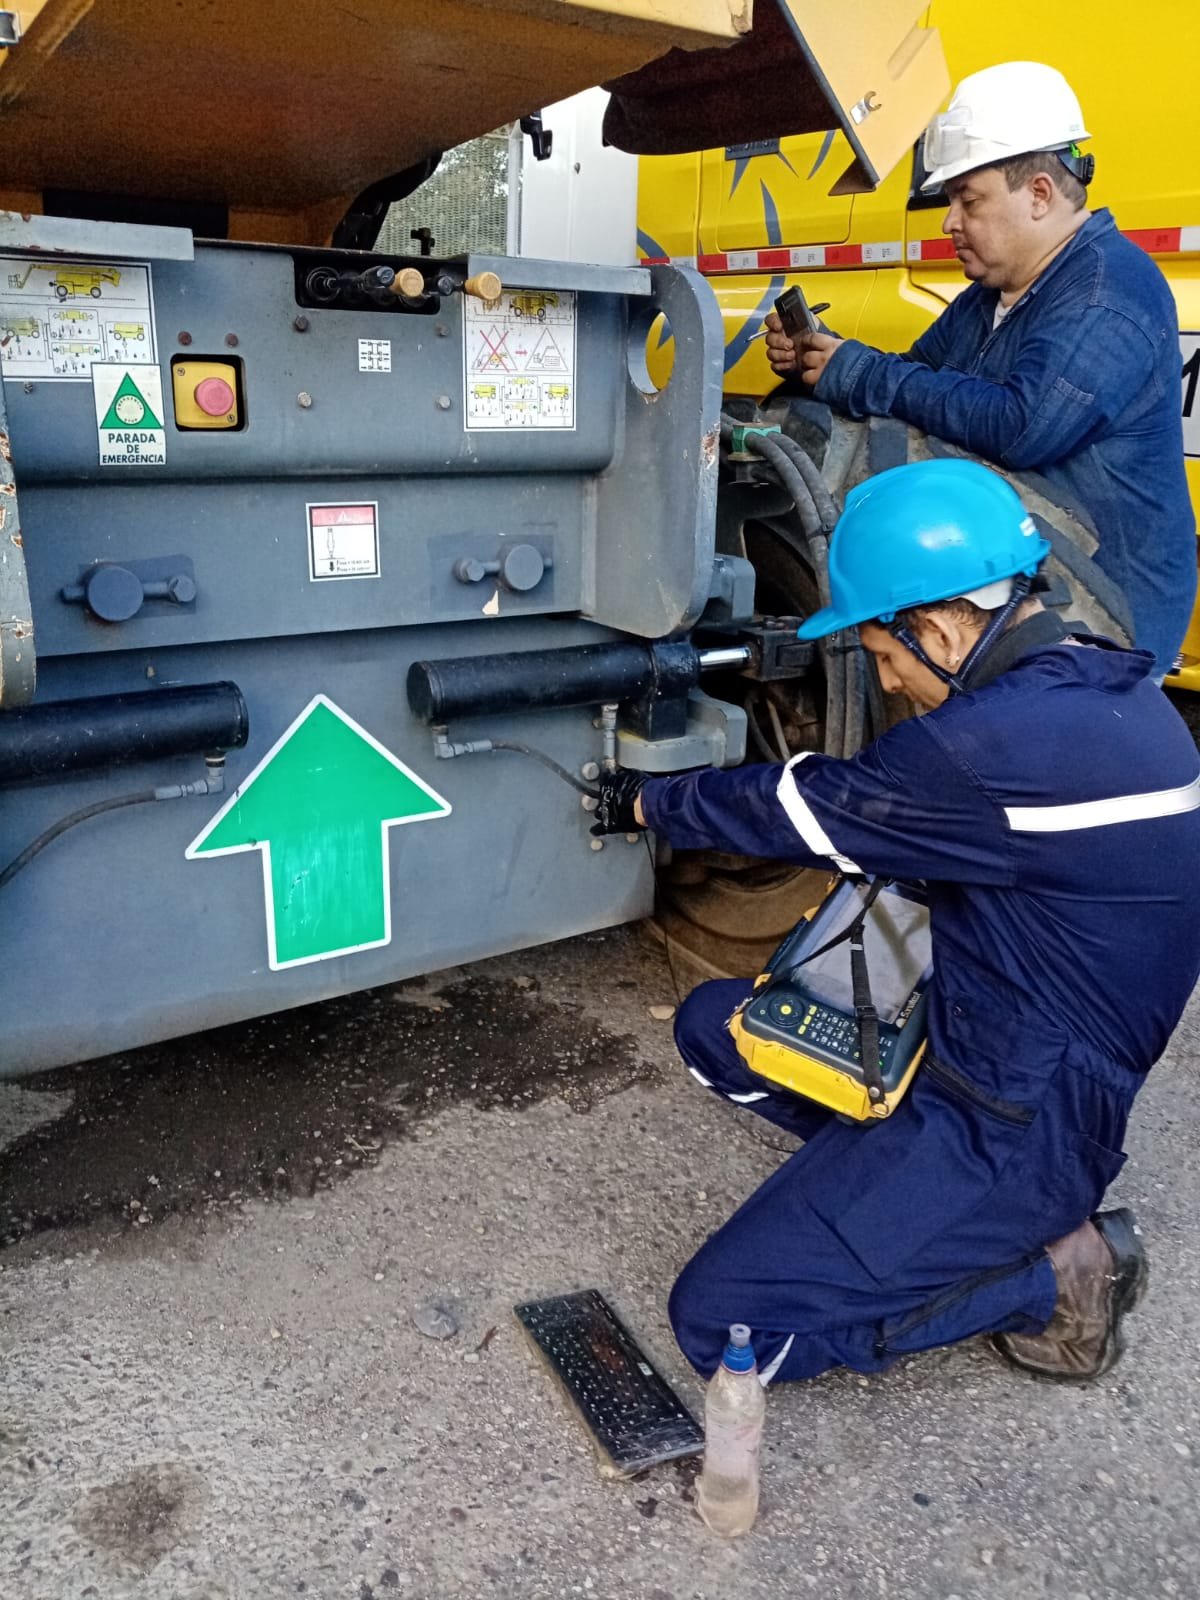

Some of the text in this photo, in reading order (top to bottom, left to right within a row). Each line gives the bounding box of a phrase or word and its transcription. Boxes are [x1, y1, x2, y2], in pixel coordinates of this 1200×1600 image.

[108, 433, 156, 444] PARADA
[126, 444, 140, 454] DE
[102, 454, 164, 464] EMERGENCIA
